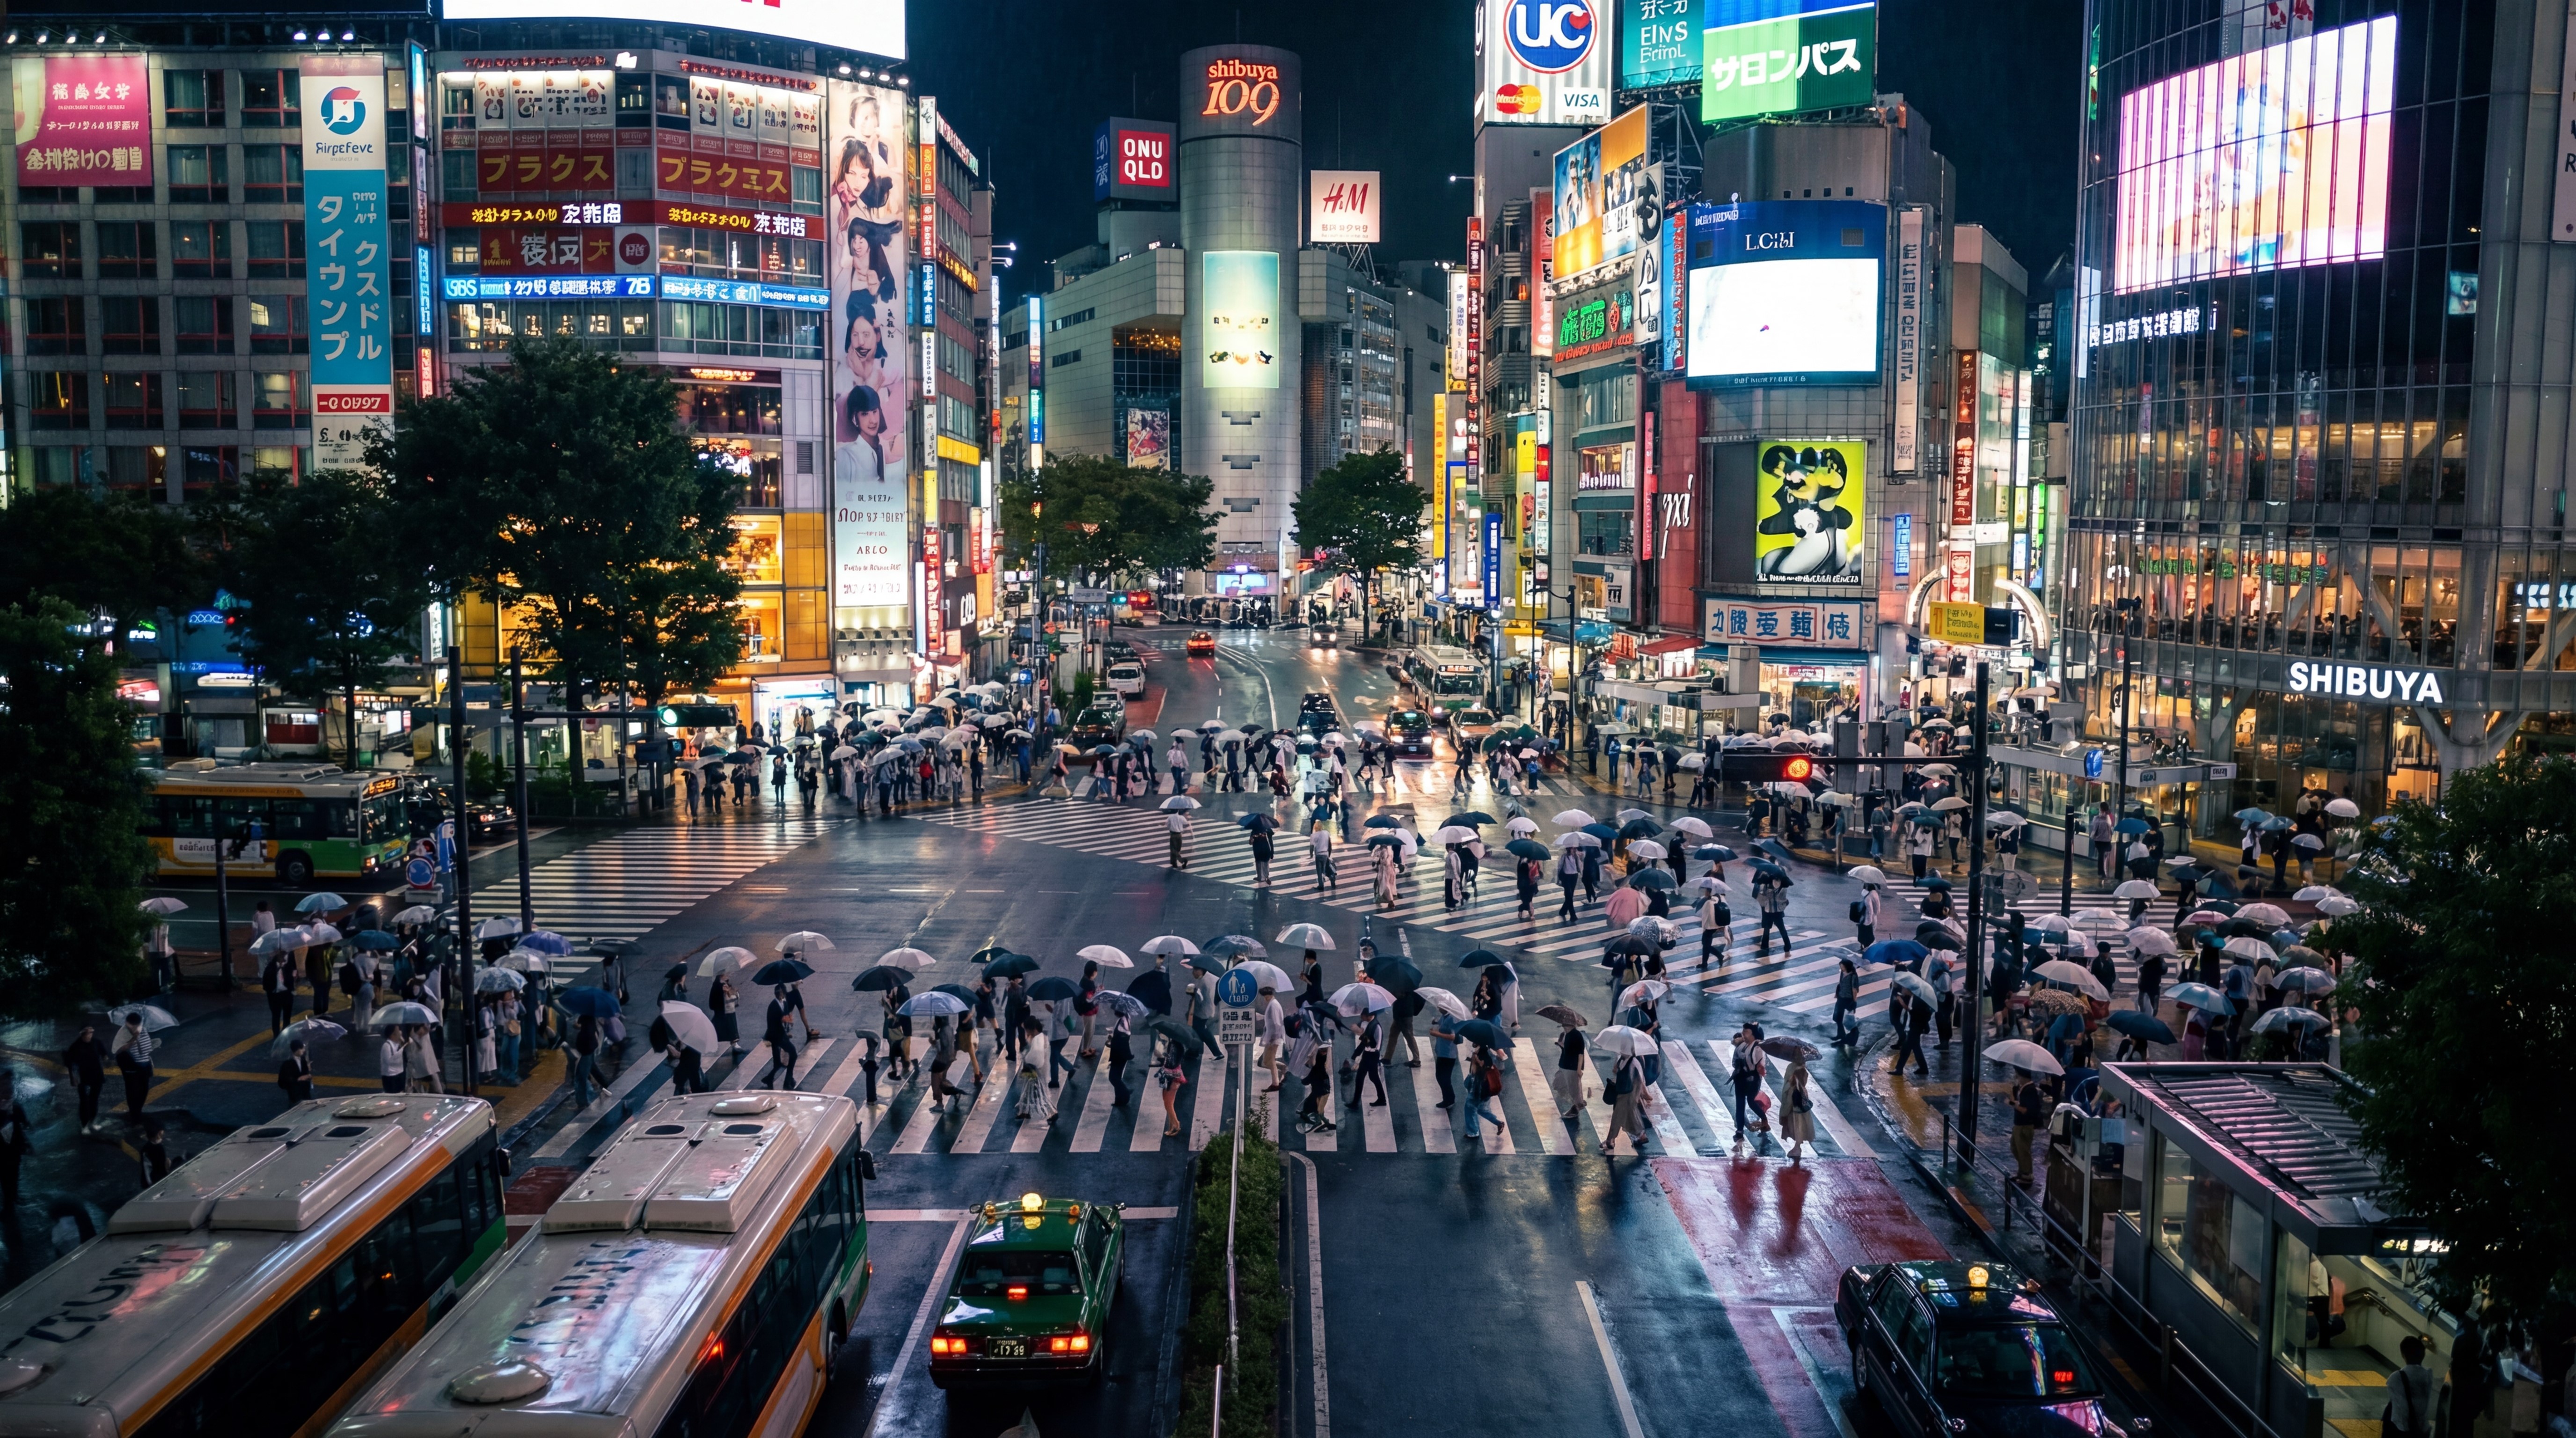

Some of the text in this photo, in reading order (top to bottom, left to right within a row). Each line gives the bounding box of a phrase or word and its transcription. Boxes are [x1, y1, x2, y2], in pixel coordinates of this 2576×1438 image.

[1516, 3, 1587, 49] UC
[1641, 21, 1688, 46] EINS
[1208, 59, 1278, 82] shibuya
[1202, 79, 1280, 126] 109
[1564, 94, 1599, 107] VISA
[1124, 138, 1162, 159] ONU
[1124, 160, 1163, 181] QLD
[2289, 661, 2443, 704] SHIBUYA
